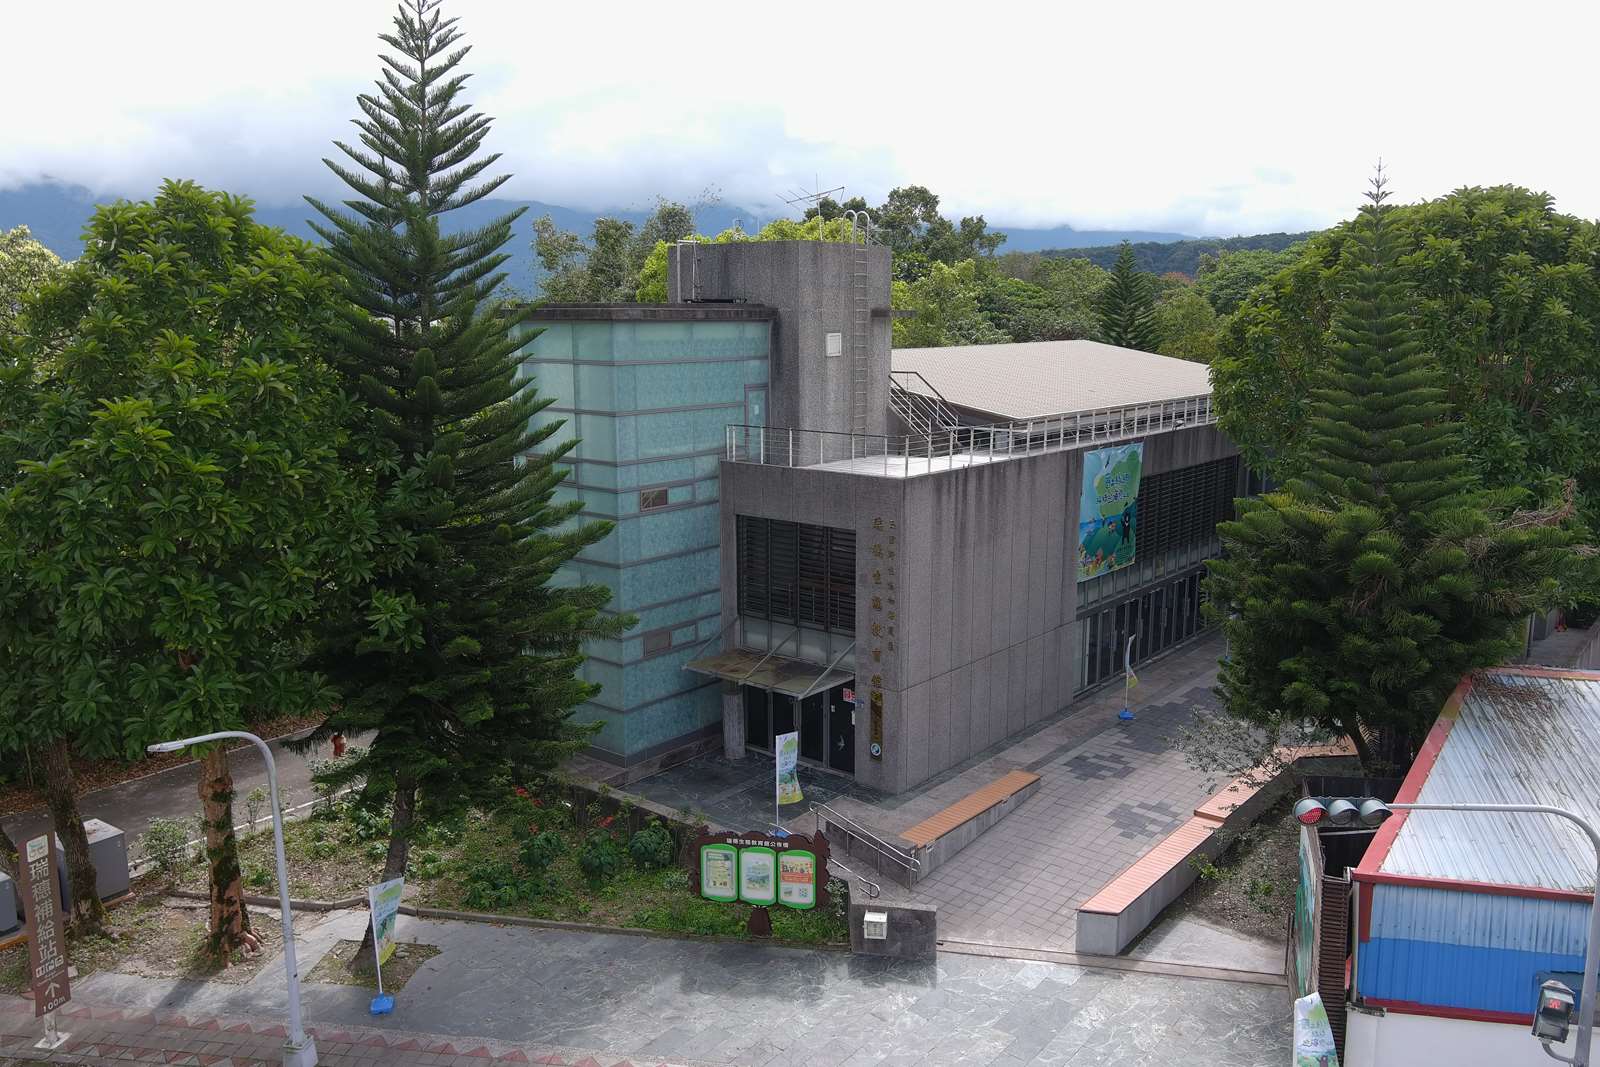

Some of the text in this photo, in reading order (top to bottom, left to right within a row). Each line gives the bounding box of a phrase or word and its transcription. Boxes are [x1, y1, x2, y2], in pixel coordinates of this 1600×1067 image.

[29, 858, 57, 963] 瑞穗補給站
[42, 996, 66, 1013] 100m
